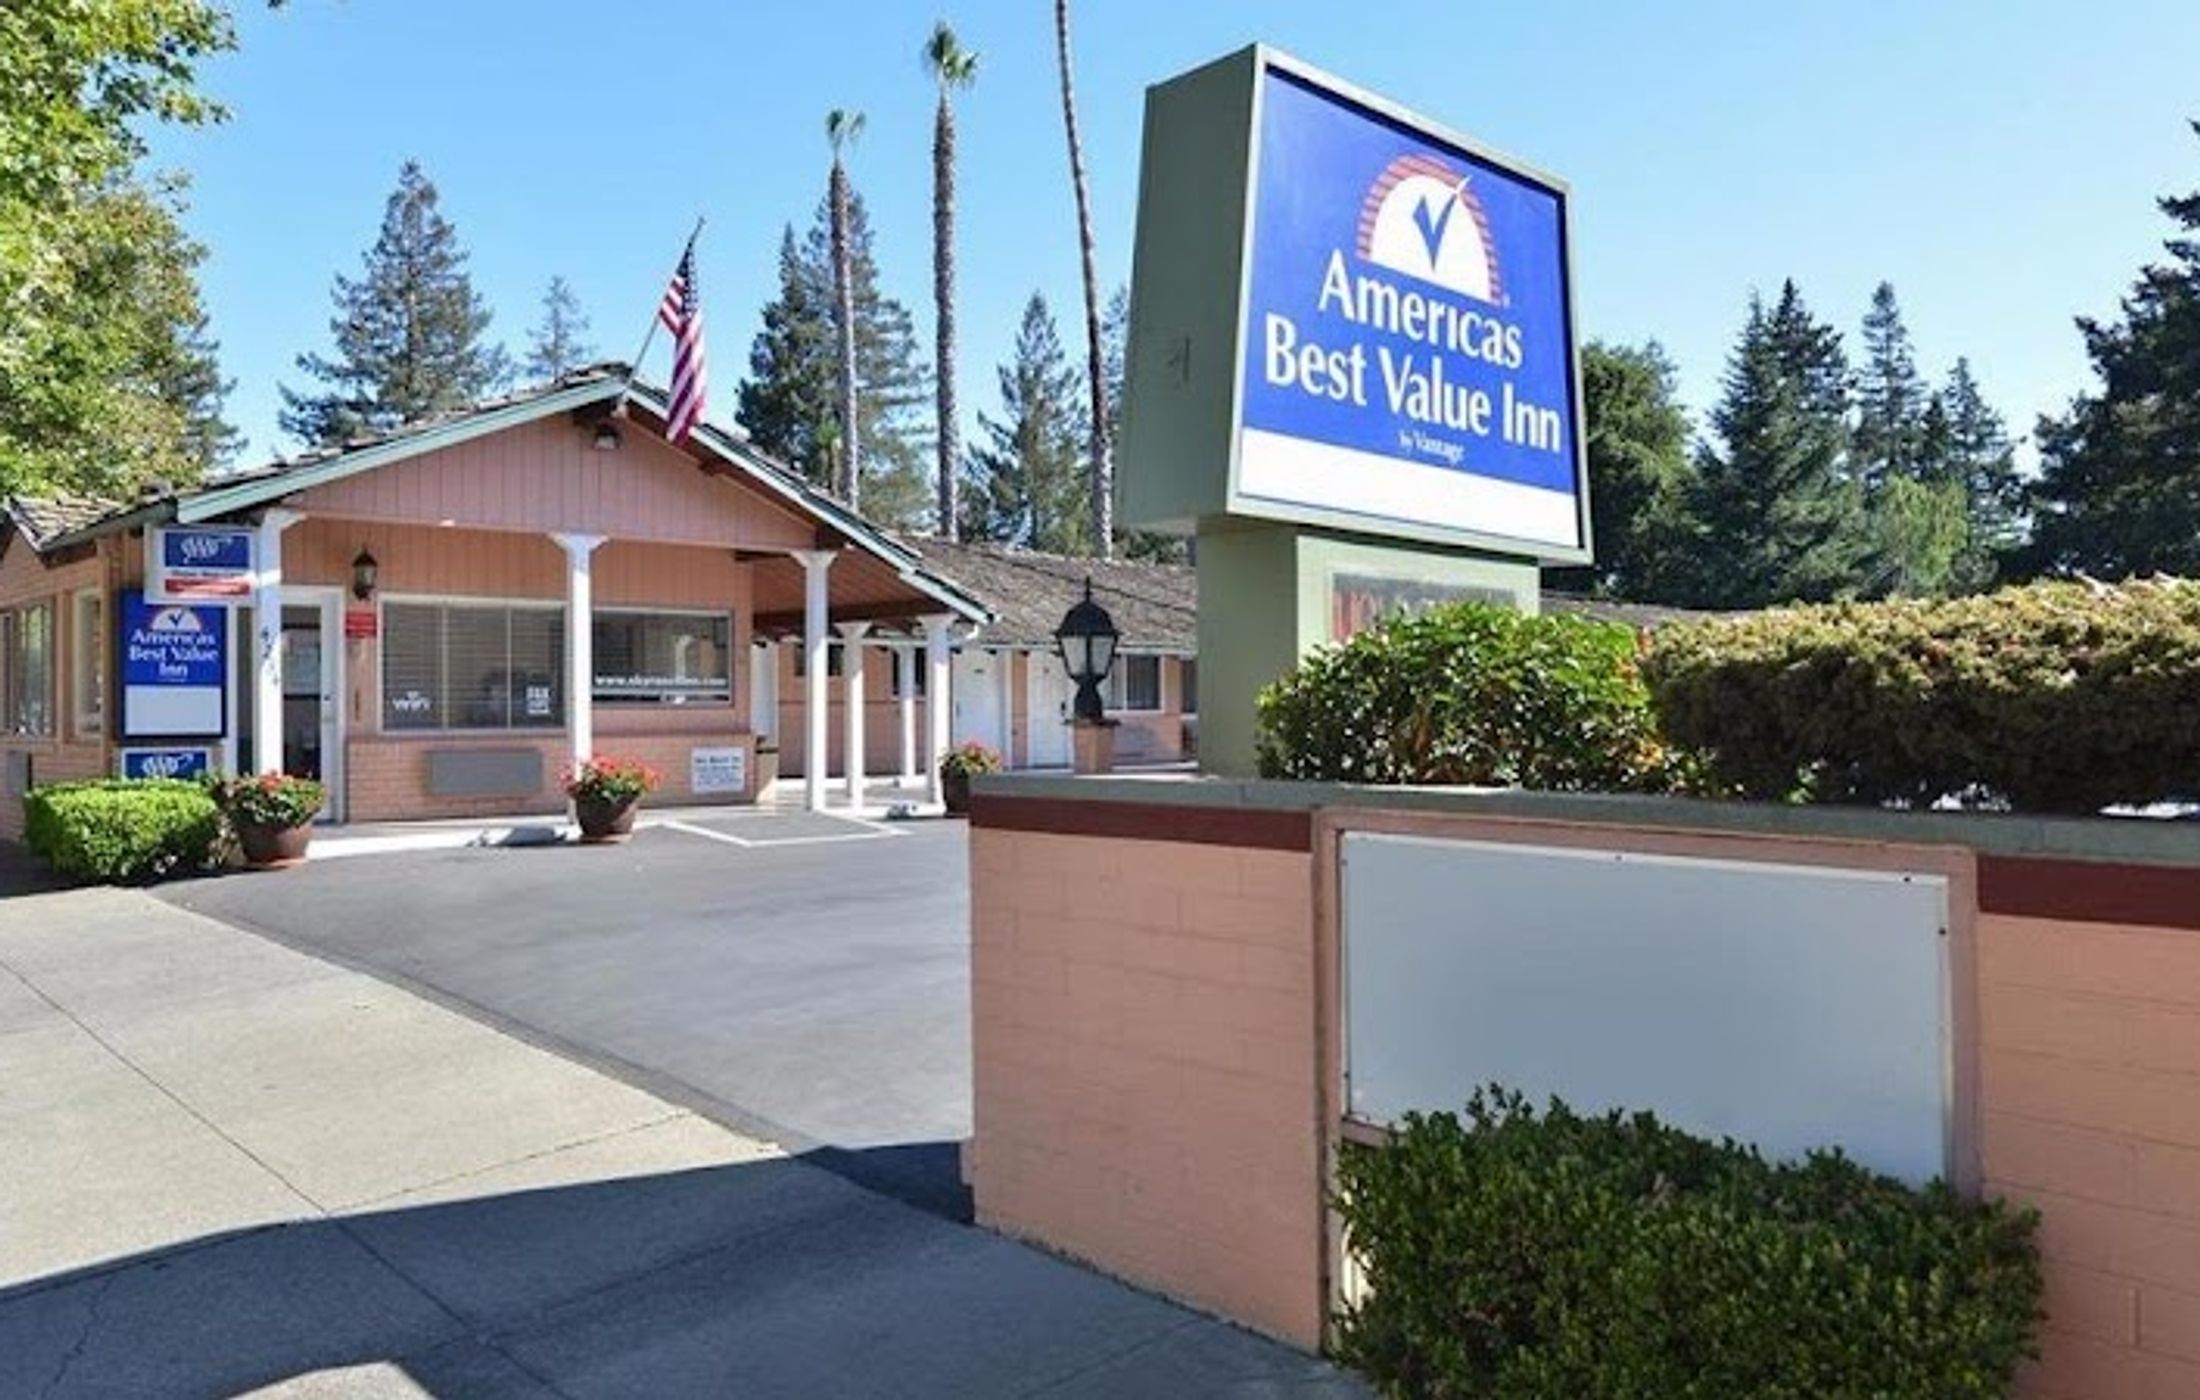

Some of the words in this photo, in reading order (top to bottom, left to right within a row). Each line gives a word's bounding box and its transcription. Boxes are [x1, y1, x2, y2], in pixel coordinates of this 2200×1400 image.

[1317, 248, 1523, 370] Americas
[1265, 311, 1368, 407] Best
[1377, 345, 1492, 437] Value
[1503, 382, 1562, 453] Inn
[1399, 430, 1413, 457] by
[1412, 430, 1464, 465] Vantage
[131, 629, 217, 645] Americas
[129, 645, 167, 661] Best
[171, 646, 219, 661] Value
[159, 662, 188, 677] Inn
